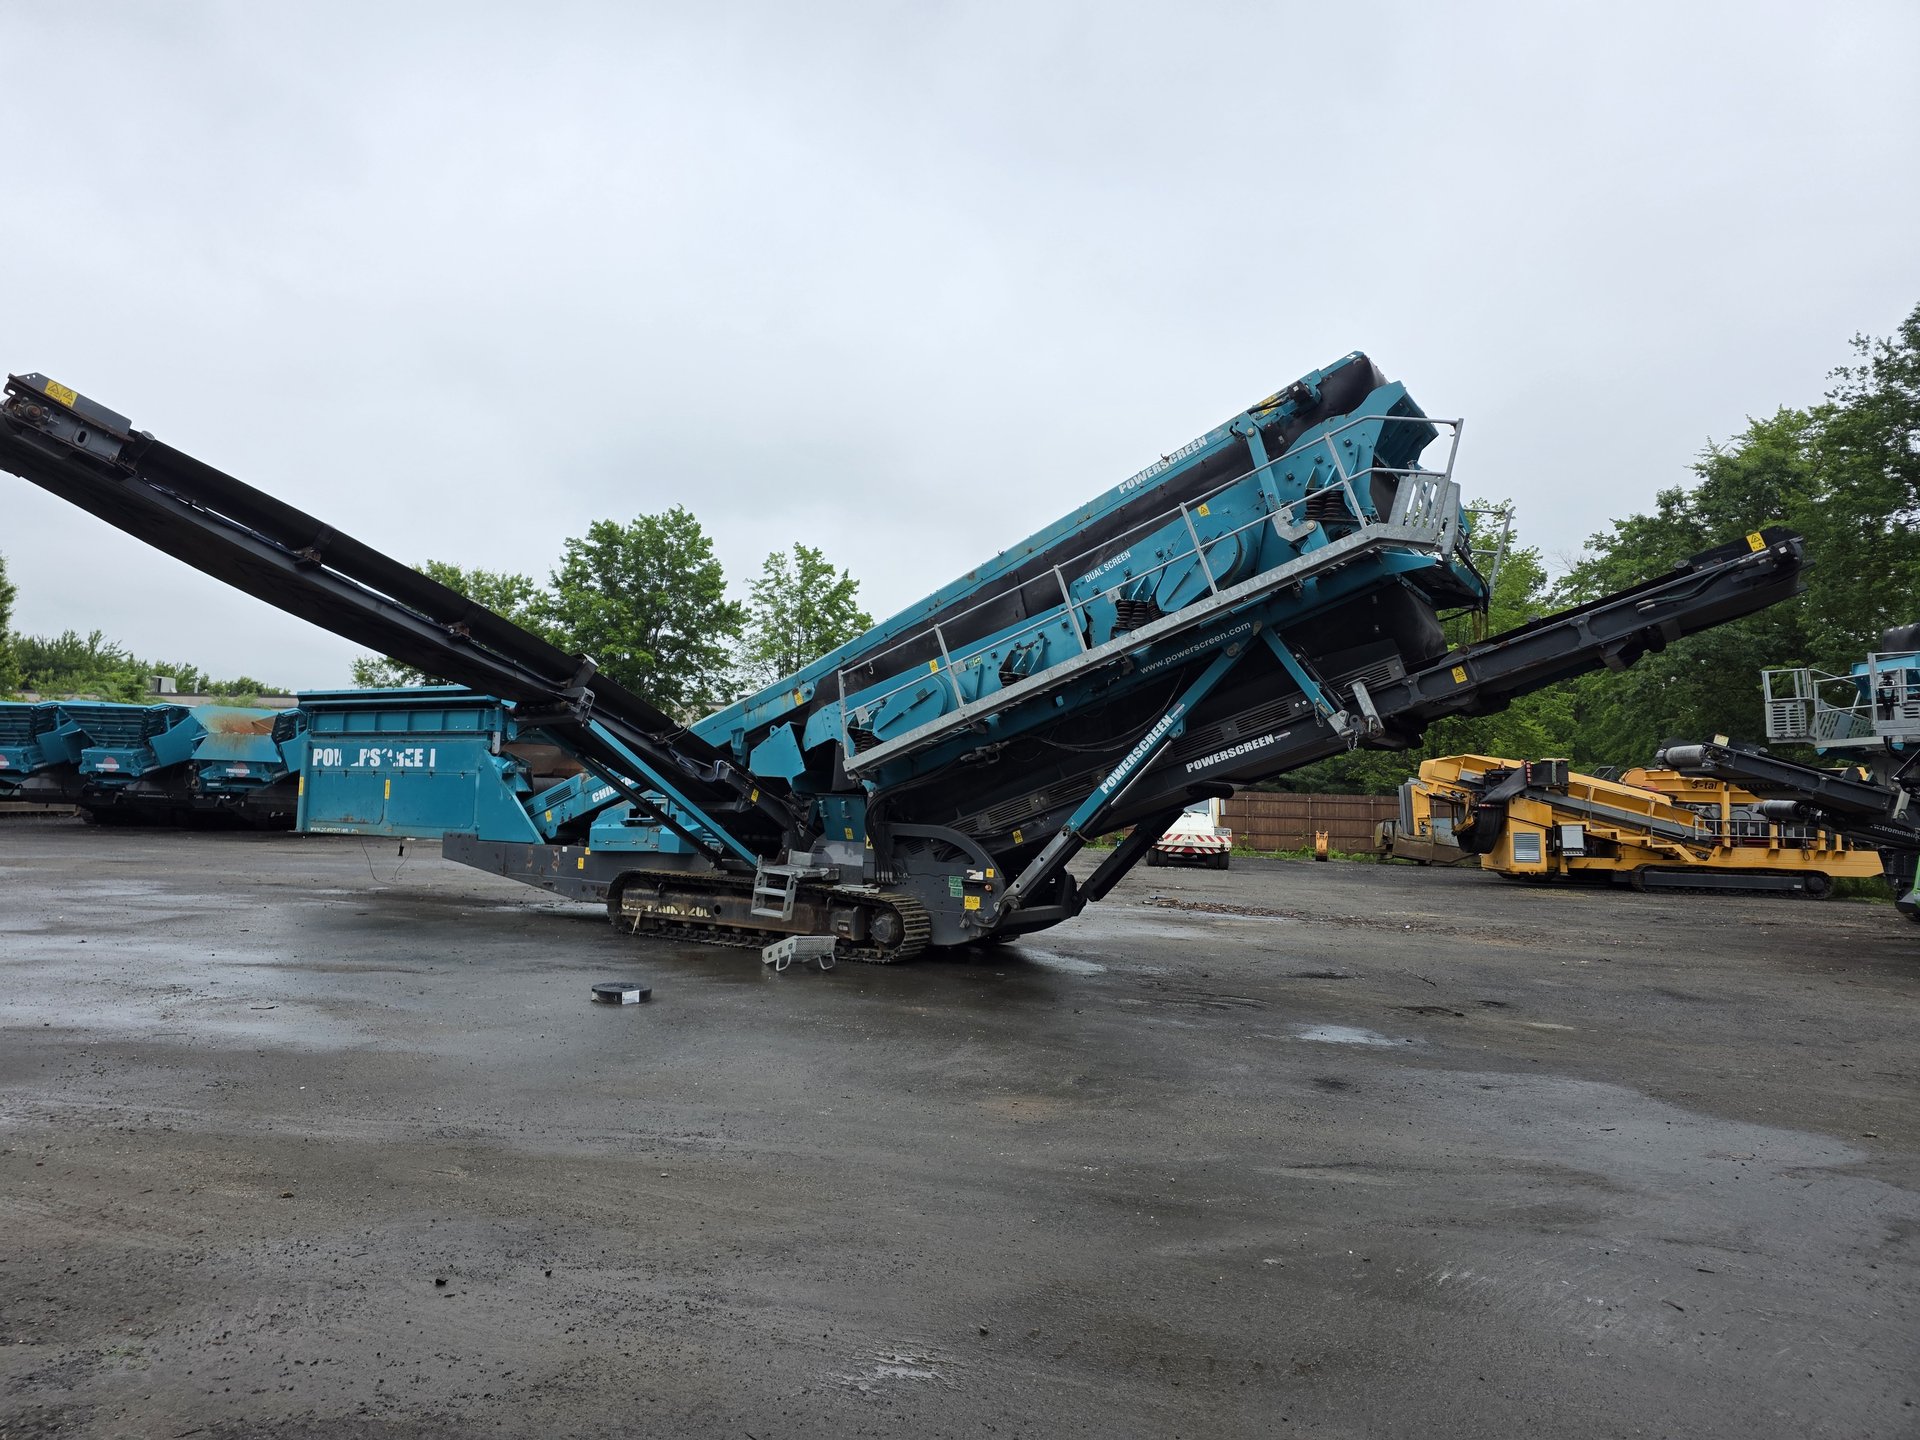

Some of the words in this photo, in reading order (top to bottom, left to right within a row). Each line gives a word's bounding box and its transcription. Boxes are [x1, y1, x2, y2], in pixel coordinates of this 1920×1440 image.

[1118, 435, 1208, 494] POWERSCREEN
[1084, 568, 1105, 583] DUAL
[1103, 550, 1131, 572] SCREEN
[1140, 621, 1251, 674] www.powerscreen.com
[1100, 714, 1174, 795] POWERSCREEN
[1185, 734, 1275, 773] POWERSCREEN
